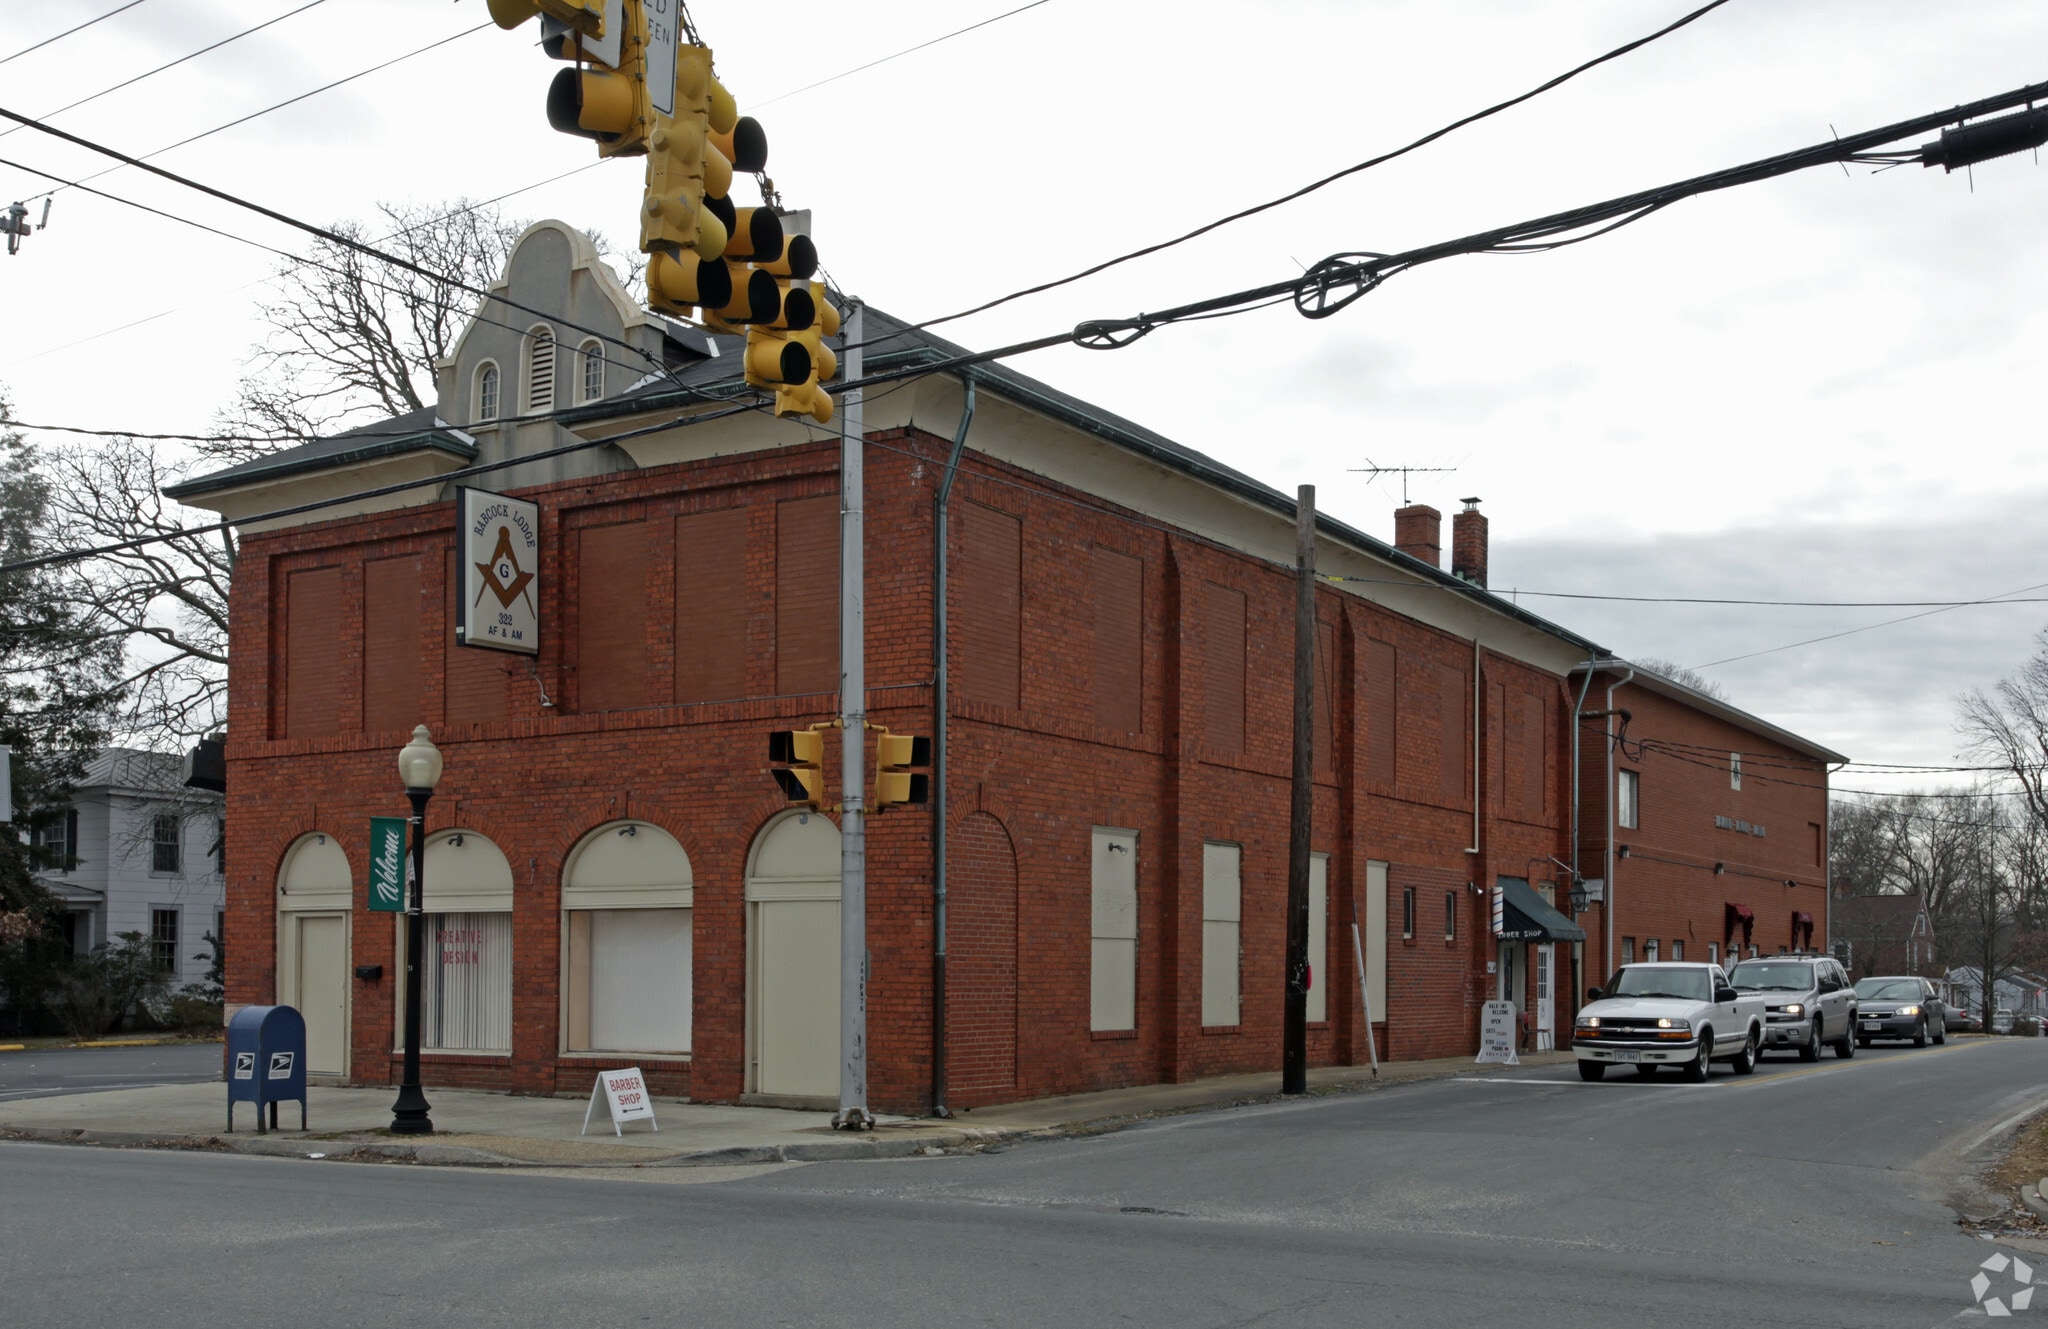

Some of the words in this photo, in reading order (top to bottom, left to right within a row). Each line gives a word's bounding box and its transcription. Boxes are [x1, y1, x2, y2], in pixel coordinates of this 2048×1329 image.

[648, 18, 670, 46] EEN
[474, 504, 509, 537] BABCOCK
[512, 510, 536, 548] LODGE
[499, 563, 509, 579] G
[498, 612, 513, 626] 322
[488, 625, 498, 636] AF
[501, 628, 507, 638] &
[511, 630, 523, 641] AM
[374, 827, 399, 903] Welcome
[436, 929, 482, 944] CREATIVE
[1523, 929, 1543, 938] SHOP
[442, 951, 478, 964] DESIGN
[609, 1077, 642, 1092] BARBER
[618, 1093, 641, 1106] SHOP
